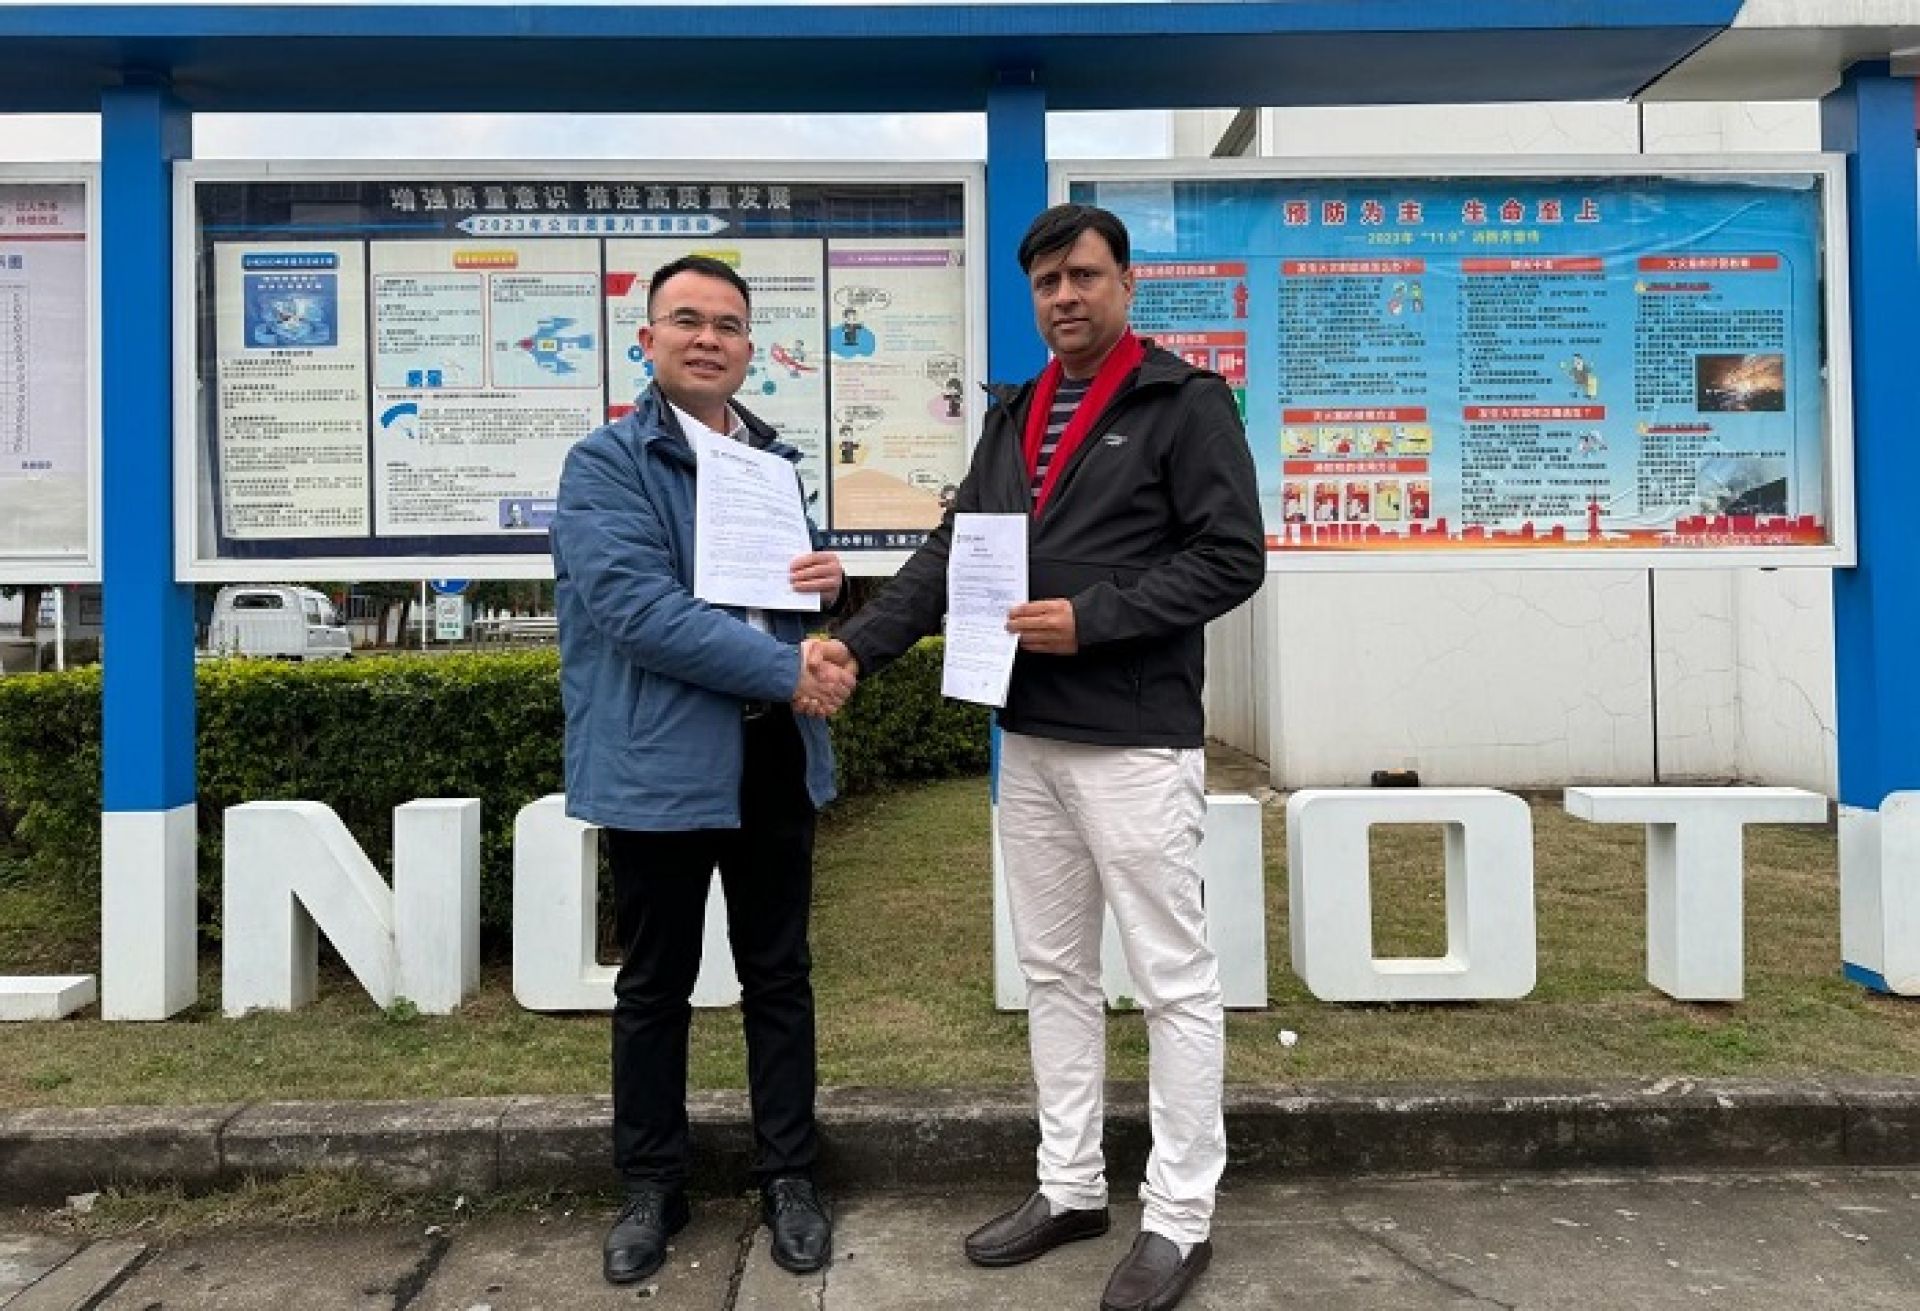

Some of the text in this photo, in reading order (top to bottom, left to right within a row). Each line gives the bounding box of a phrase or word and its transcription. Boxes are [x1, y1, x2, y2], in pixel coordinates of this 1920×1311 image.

[390, 184, 791, 211] 增强质量意识 推进高质量发展
[1283, 198, 1601, 226] 预防为主 生命至上
